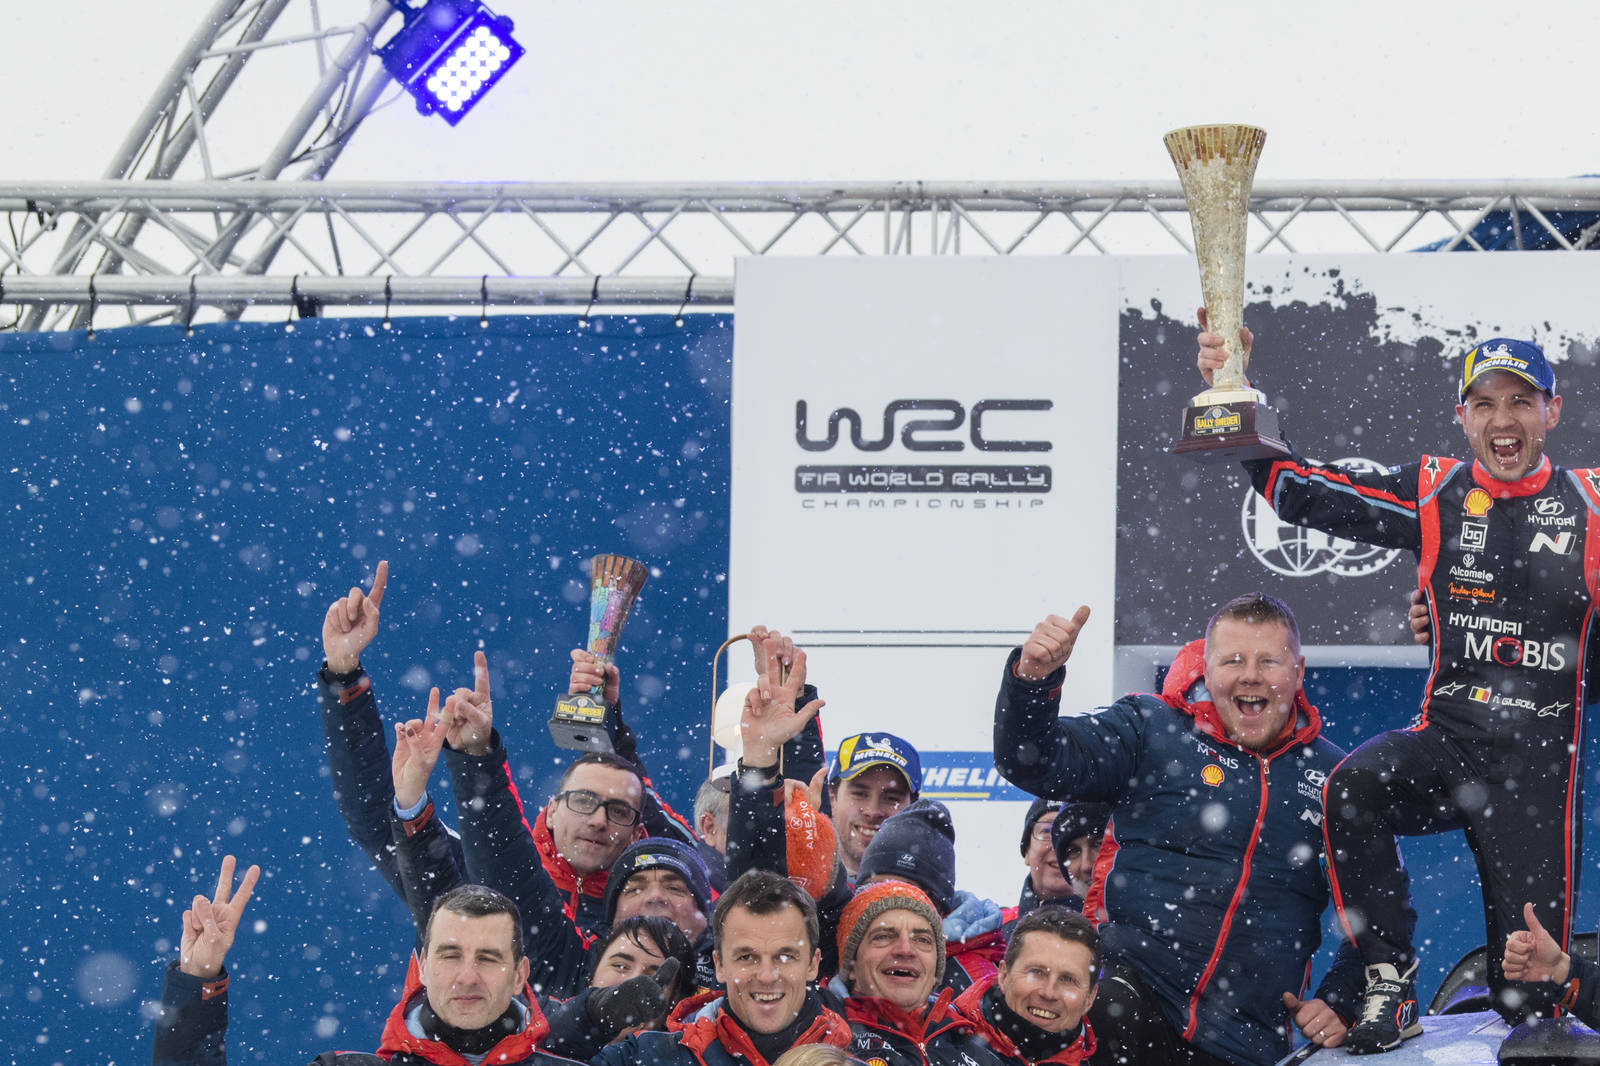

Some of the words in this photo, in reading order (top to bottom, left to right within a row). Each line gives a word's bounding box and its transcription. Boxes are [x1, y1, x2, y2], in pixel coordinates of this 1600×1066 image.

[1473, 358, 1528, 374] MICHELIN
[796, 398, 1053, 451] WRC
[801, 472, 840, 486] FIA
[849, 472, 944, 486] WORLD
[952, 472, 1046, 486] RALLY
[801, 498, 1044, 509] CHAMPIONSHIP
[1528, 514, 1576, 526] HYUNDAI
[1449, 612, 1522, 636] HYUNDAI
[1464, 632, 1566, 671] MOBIS
[853, 750, 907, 768] MICHELIN
[1197, 743, 1239, 769] MOBIS
[921, 767, 1011, 787] HELI
[799, 800, 815, 850] AMEXIO
